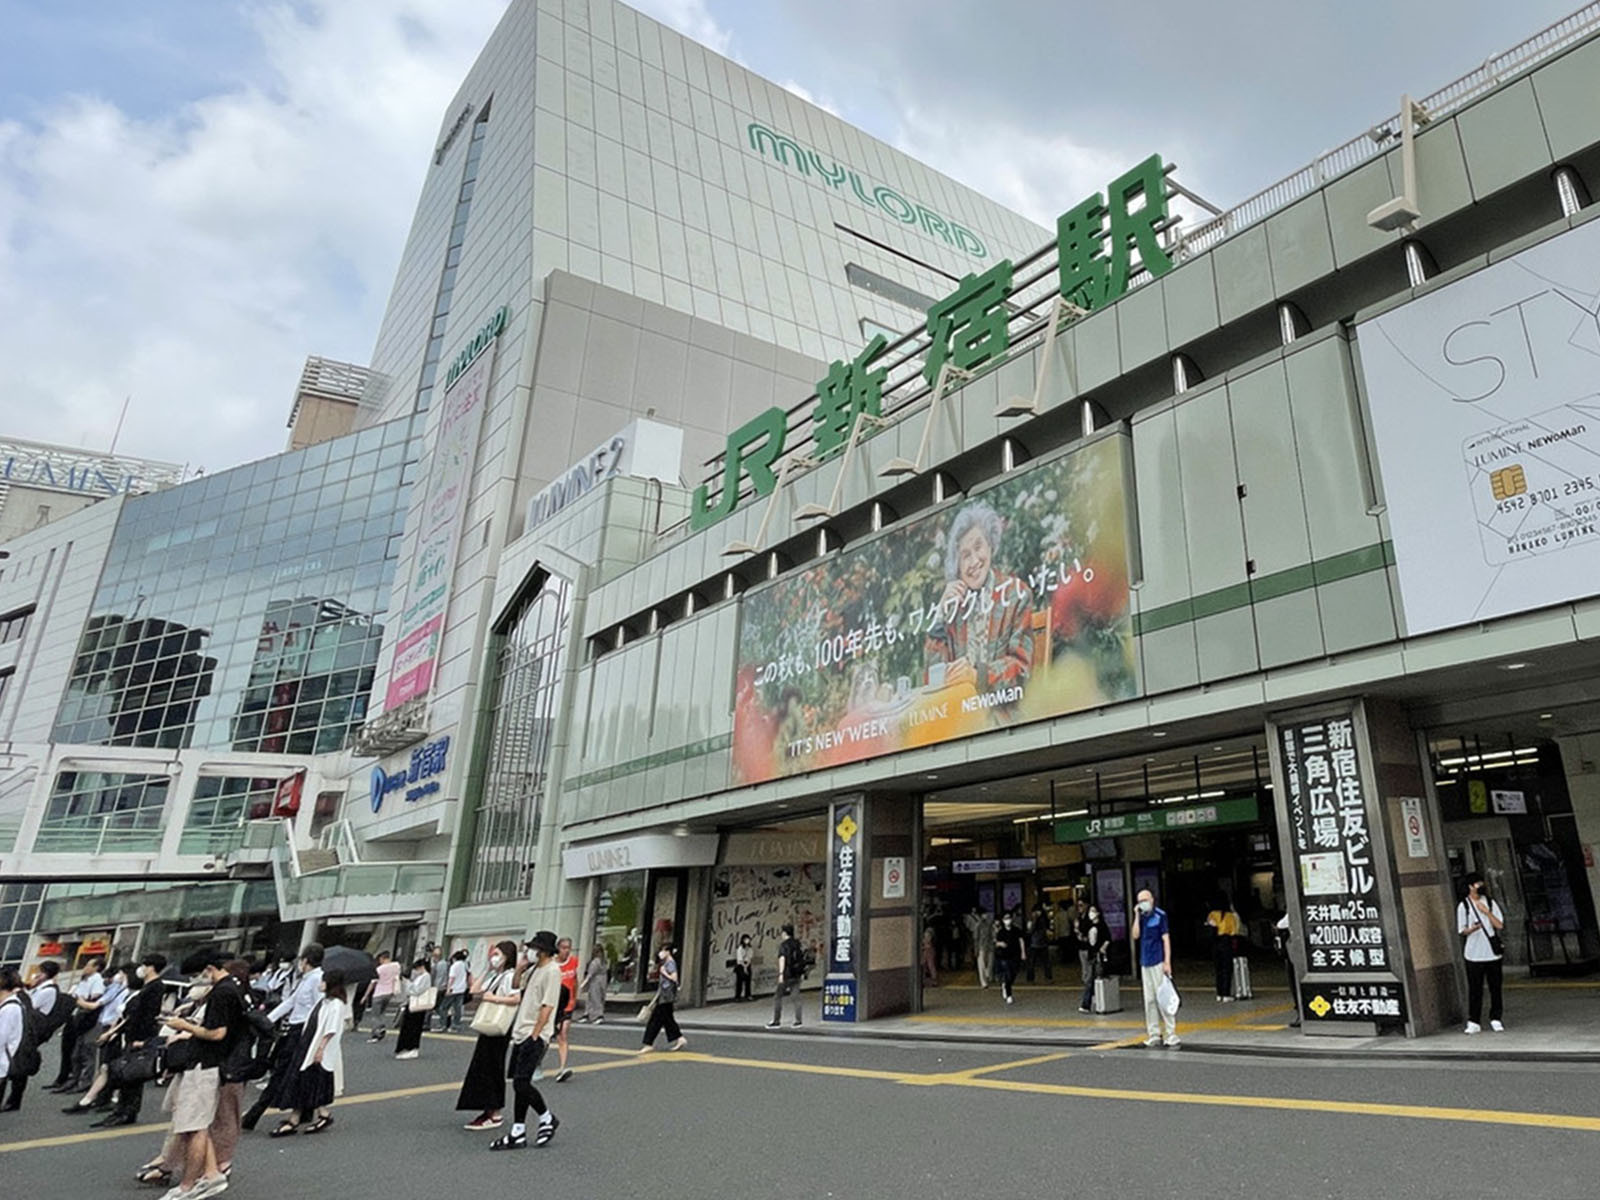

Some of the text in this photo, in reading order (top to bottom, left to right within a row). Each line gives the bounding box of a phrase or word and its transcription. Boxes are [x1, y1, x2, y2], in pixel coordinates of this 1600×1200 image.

[1301, 725, 1340, 848] 三角広場
[1327, 719, 1375, 895] 新宿住友ビル
[835, 846, 854, 962] 住友不動産
[1332, 999, 1401, 1015] 住友不動産
